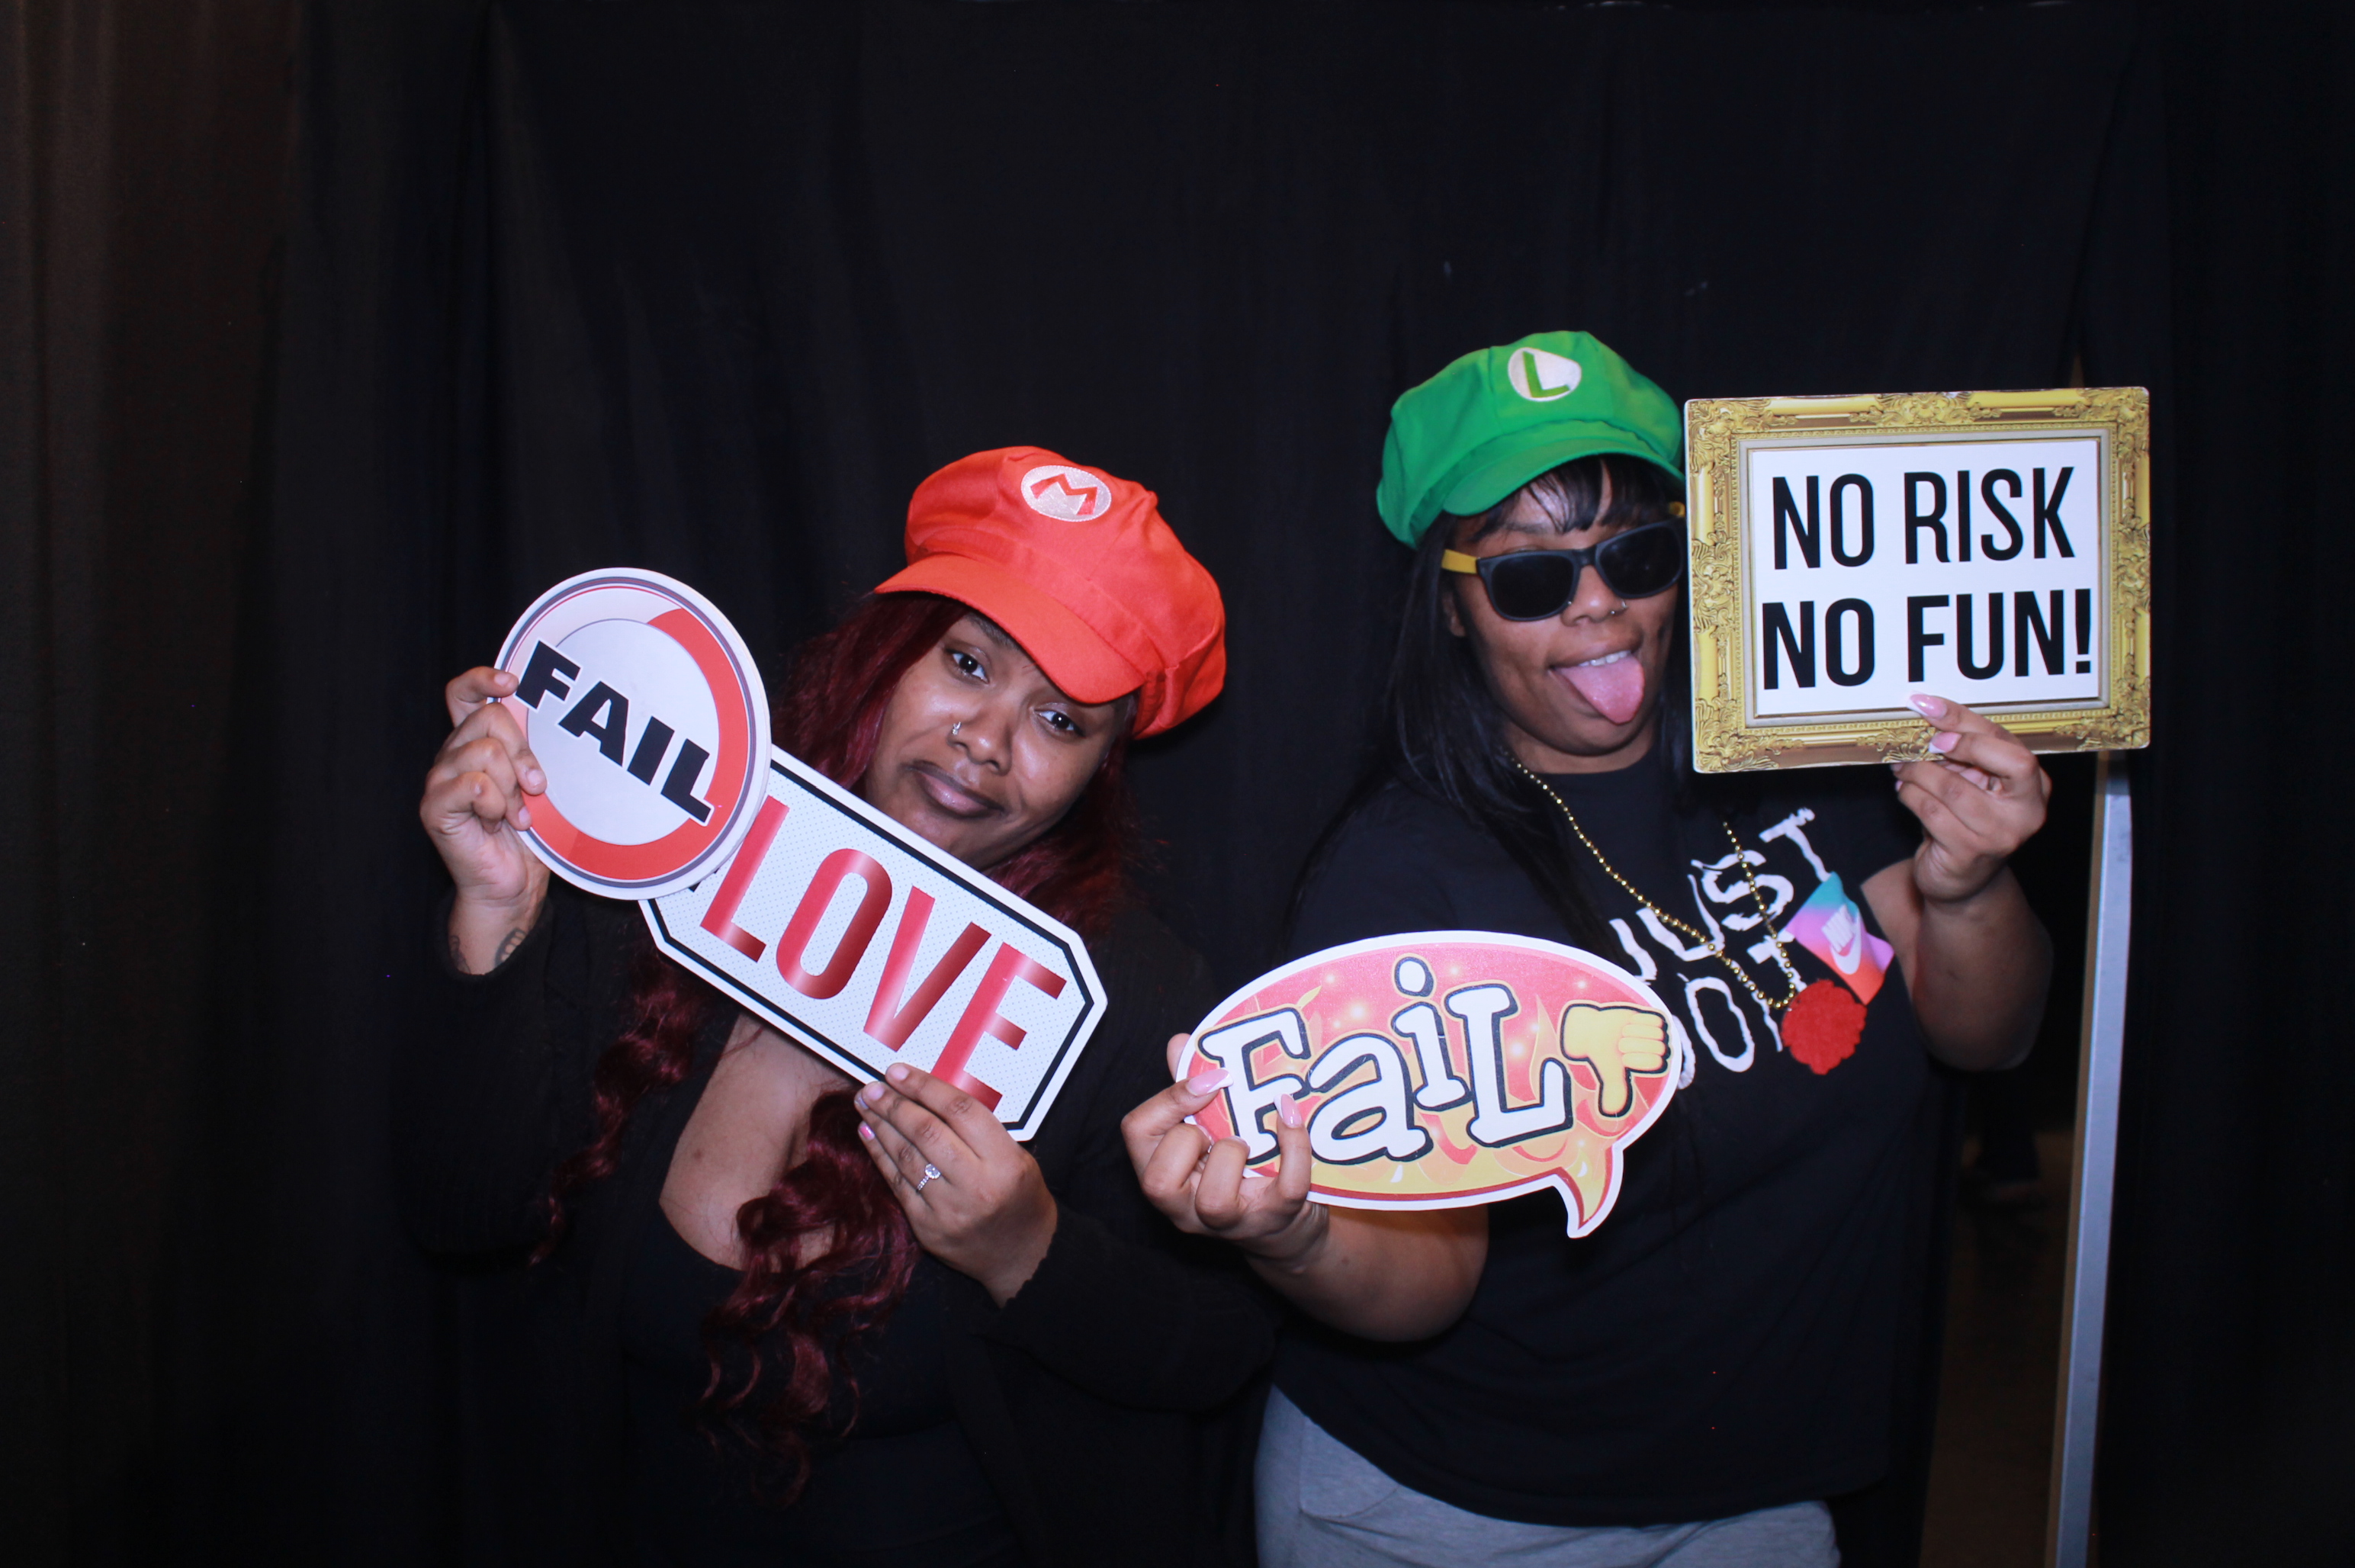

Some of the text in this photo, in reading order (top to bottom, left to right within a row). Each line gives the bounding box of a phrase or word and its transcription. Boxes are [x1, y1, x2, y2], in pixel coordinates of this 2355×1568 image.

[1523, 350, 1571, 398] L
[1030, 473, 1098, 516] M
[1772, 466, 2076, 570] NO RISK
[1761, 588, 2092, 691] NO FUN!
[513, 640, 715, 824] FAIL
[1608, 807, 1832, 985] JUST
[700, 795, 1068, 1113] LOVE
